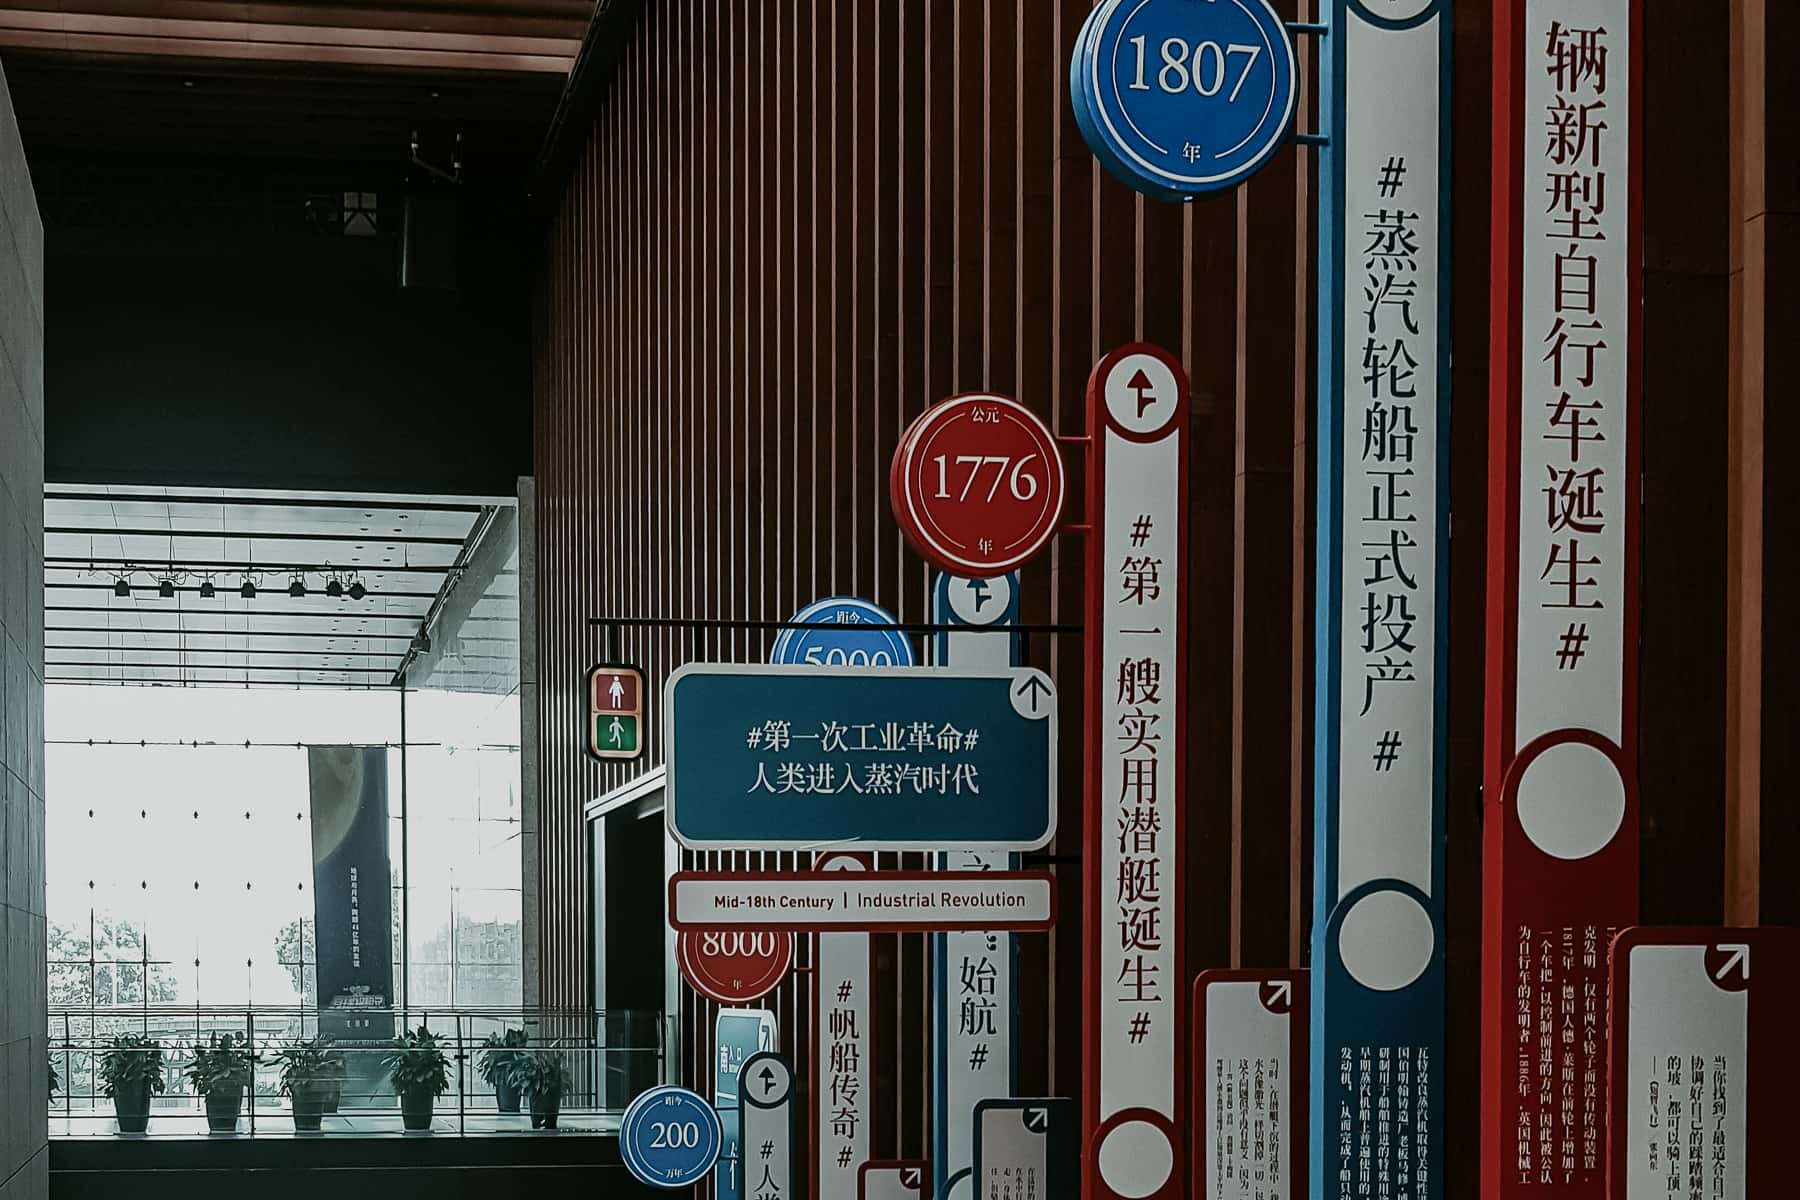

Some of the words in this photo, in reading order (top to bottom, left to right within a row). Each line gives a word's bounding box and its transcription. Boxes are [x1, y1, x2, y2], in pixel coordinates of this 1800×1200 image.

[1128, 34, 1262, 102] 1807
[1183, 142, 1200, 163] 年
[1541, 21, 1607, 669] 辆新型自行车诞生#
[972, 407, 999, 422] 公元
[934, 454, 1036, 502] 1776
[1360, 157, 1418, 771] #蒸汽轮船正式投产#
[980, 538, 992, 555] 年
[747, 721, 978, 752] #第一次工业革命#
[748, 763, 978, 794] 人类进入蒸汽时代
[1117, 515, 1162, 1043] #第一艘实用潜艇诞生#
[715, 896, 775, 907] Mid-18th
[780, 896, 833, 910] Century
[857, 892, 936, 908] Industrial
[942, 892, 1024, 906] Revolution
[701, 932, 777, 958] 8000
[829, 980, 860, 1169] #帆船传奇#
[651, 1123, 698, 1147] 200
